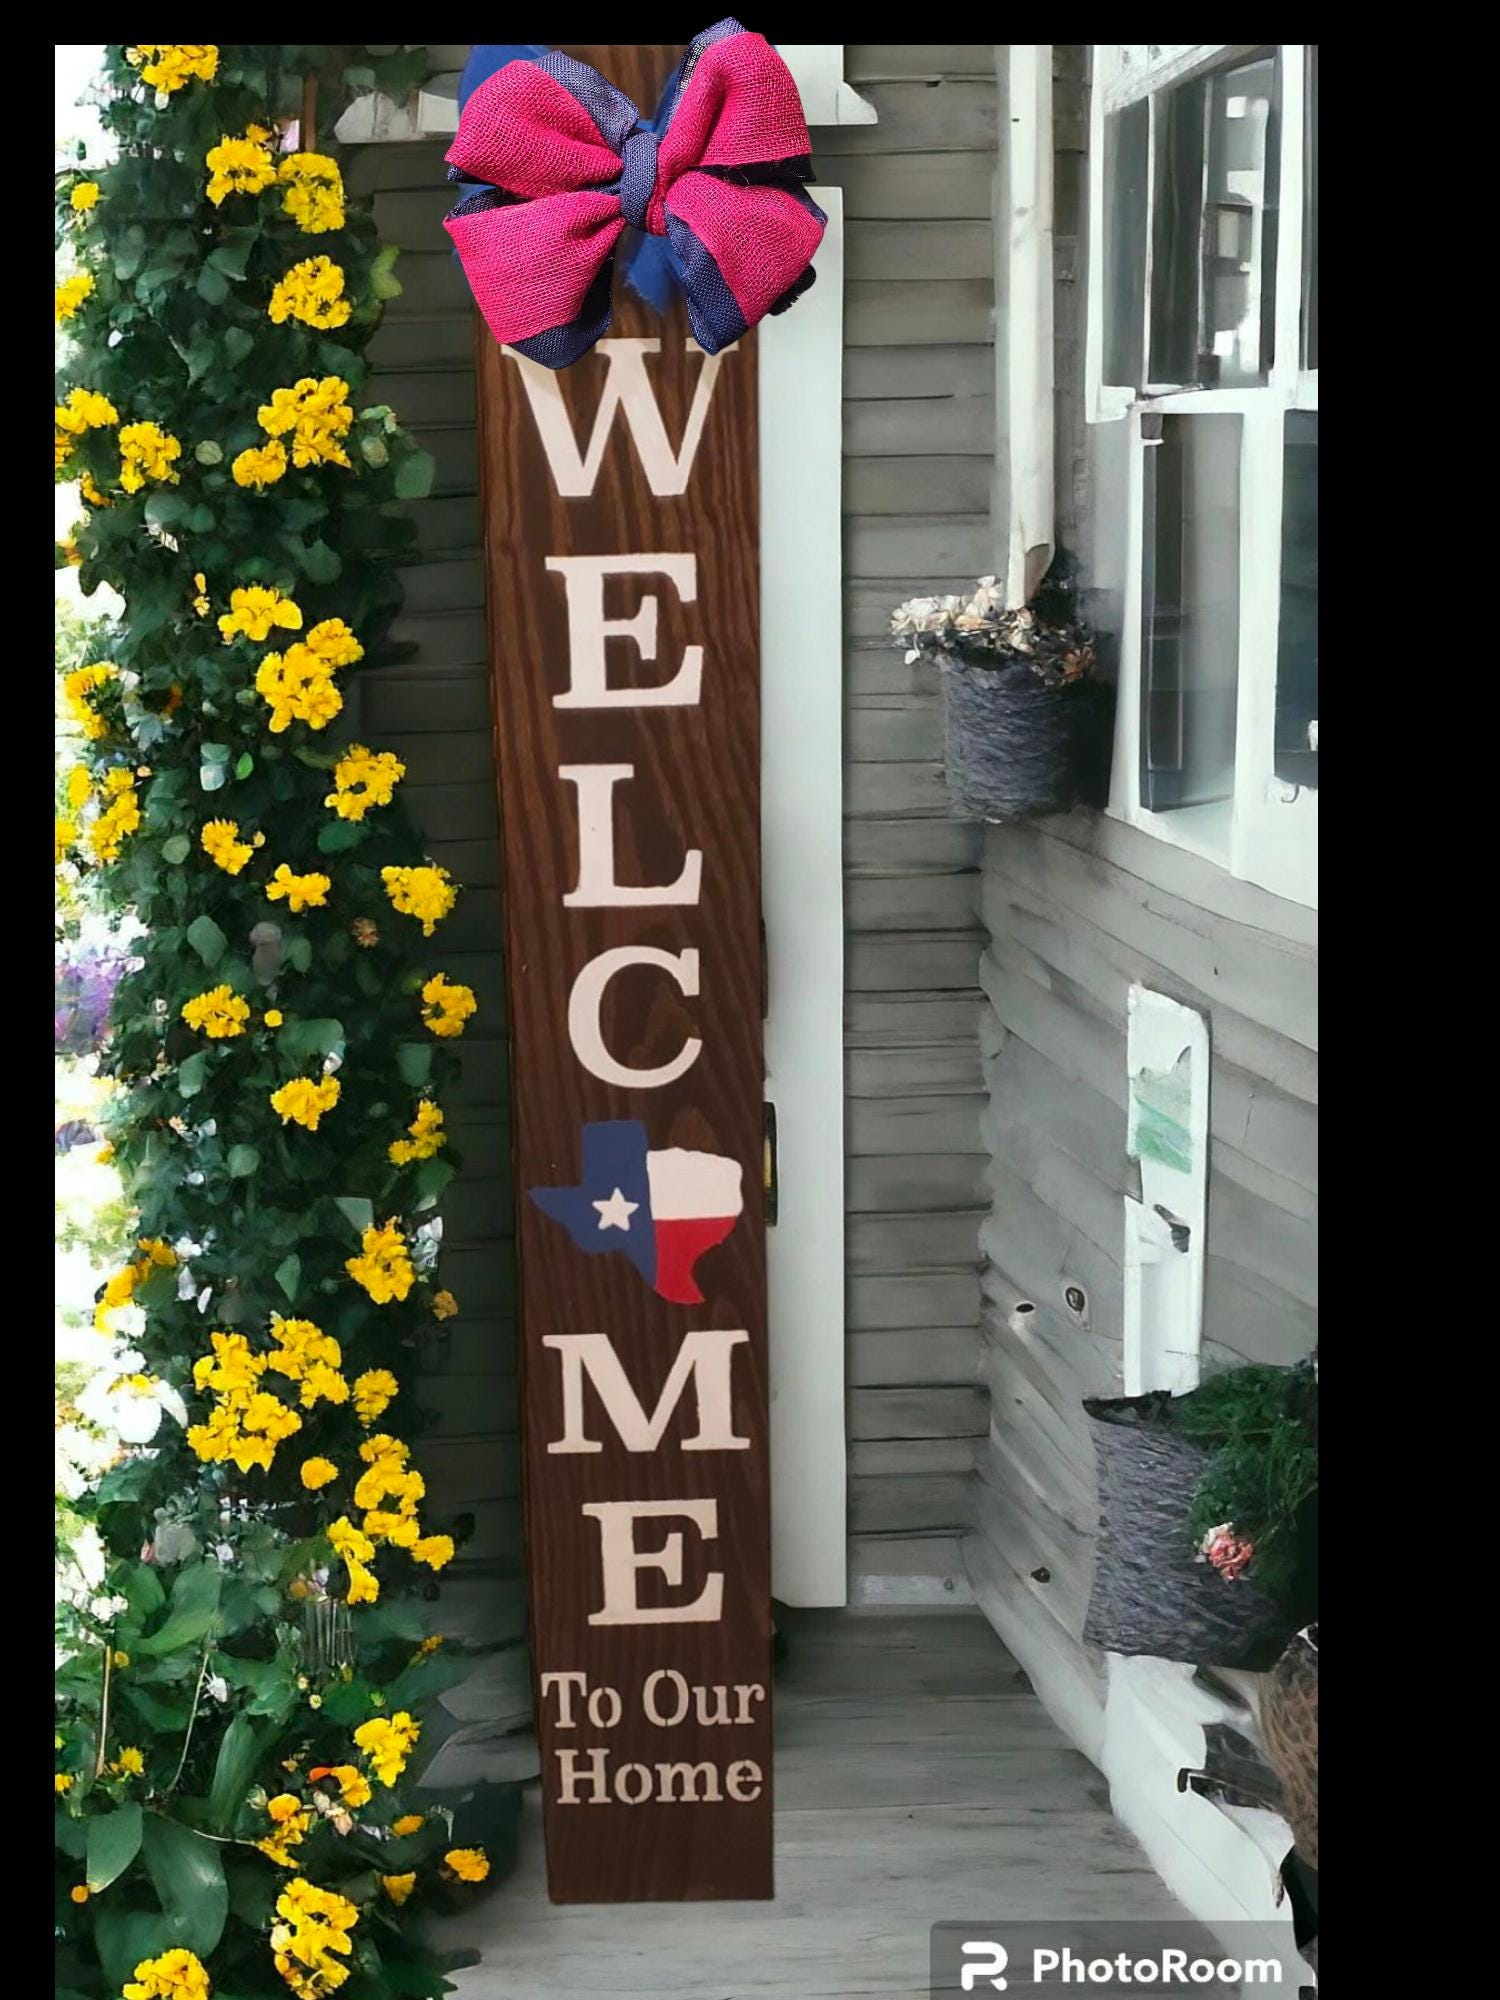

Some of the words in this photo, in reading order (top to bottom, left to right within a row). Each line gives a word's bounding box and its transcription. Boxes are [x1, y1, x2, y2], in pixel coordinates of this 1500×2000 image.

[502, 337, 750, 1625] WELCME
[541, 1671, 622, 1728] To
[643, 1669, 765, 1727] Our
[555, 1748, 763, 1804] Home
